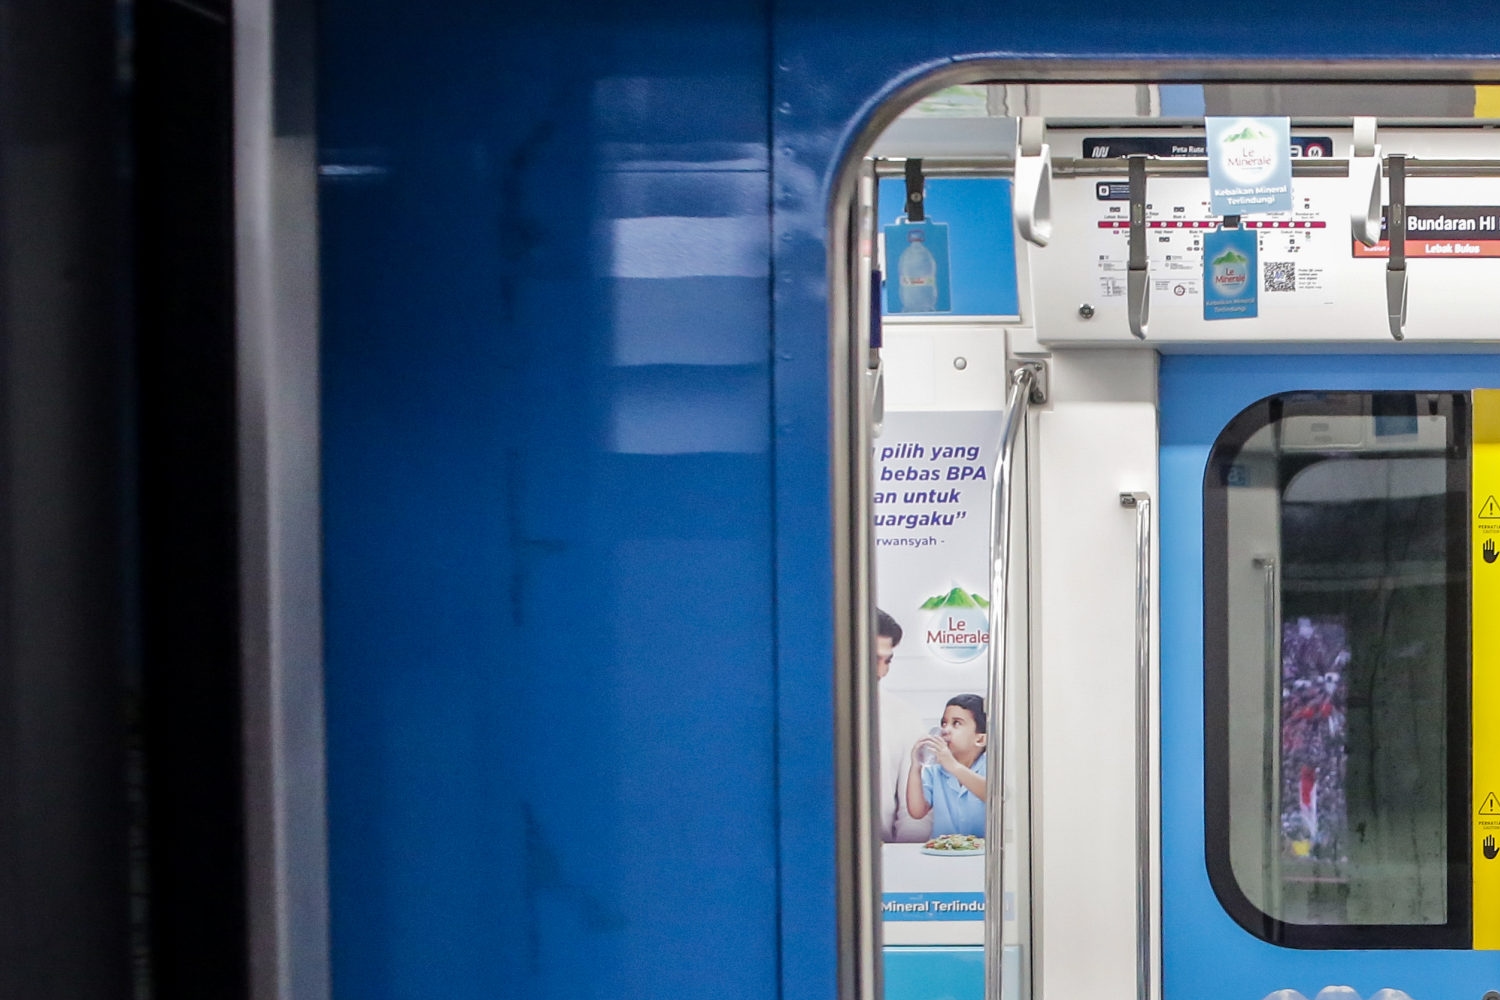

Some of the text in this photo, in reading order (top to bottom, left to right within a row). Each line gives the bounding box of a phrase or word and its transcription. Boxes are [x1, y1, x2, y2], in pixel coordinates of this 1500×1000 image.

[1242, 147, 1254, 158] Le
[1407, 215, 1476, 231] Bundaran
[1479, 215, 1496, 231] HI
[880, 443, 980, 461] pilih yang
[880, 466, 987, 481] bebas BPA
[903, 488, 961, 503] untuk
[949, 616, 966, 631] Le
[927, 630, 990, 644] Minerale
[881, 900, 929, 912] Mineral
